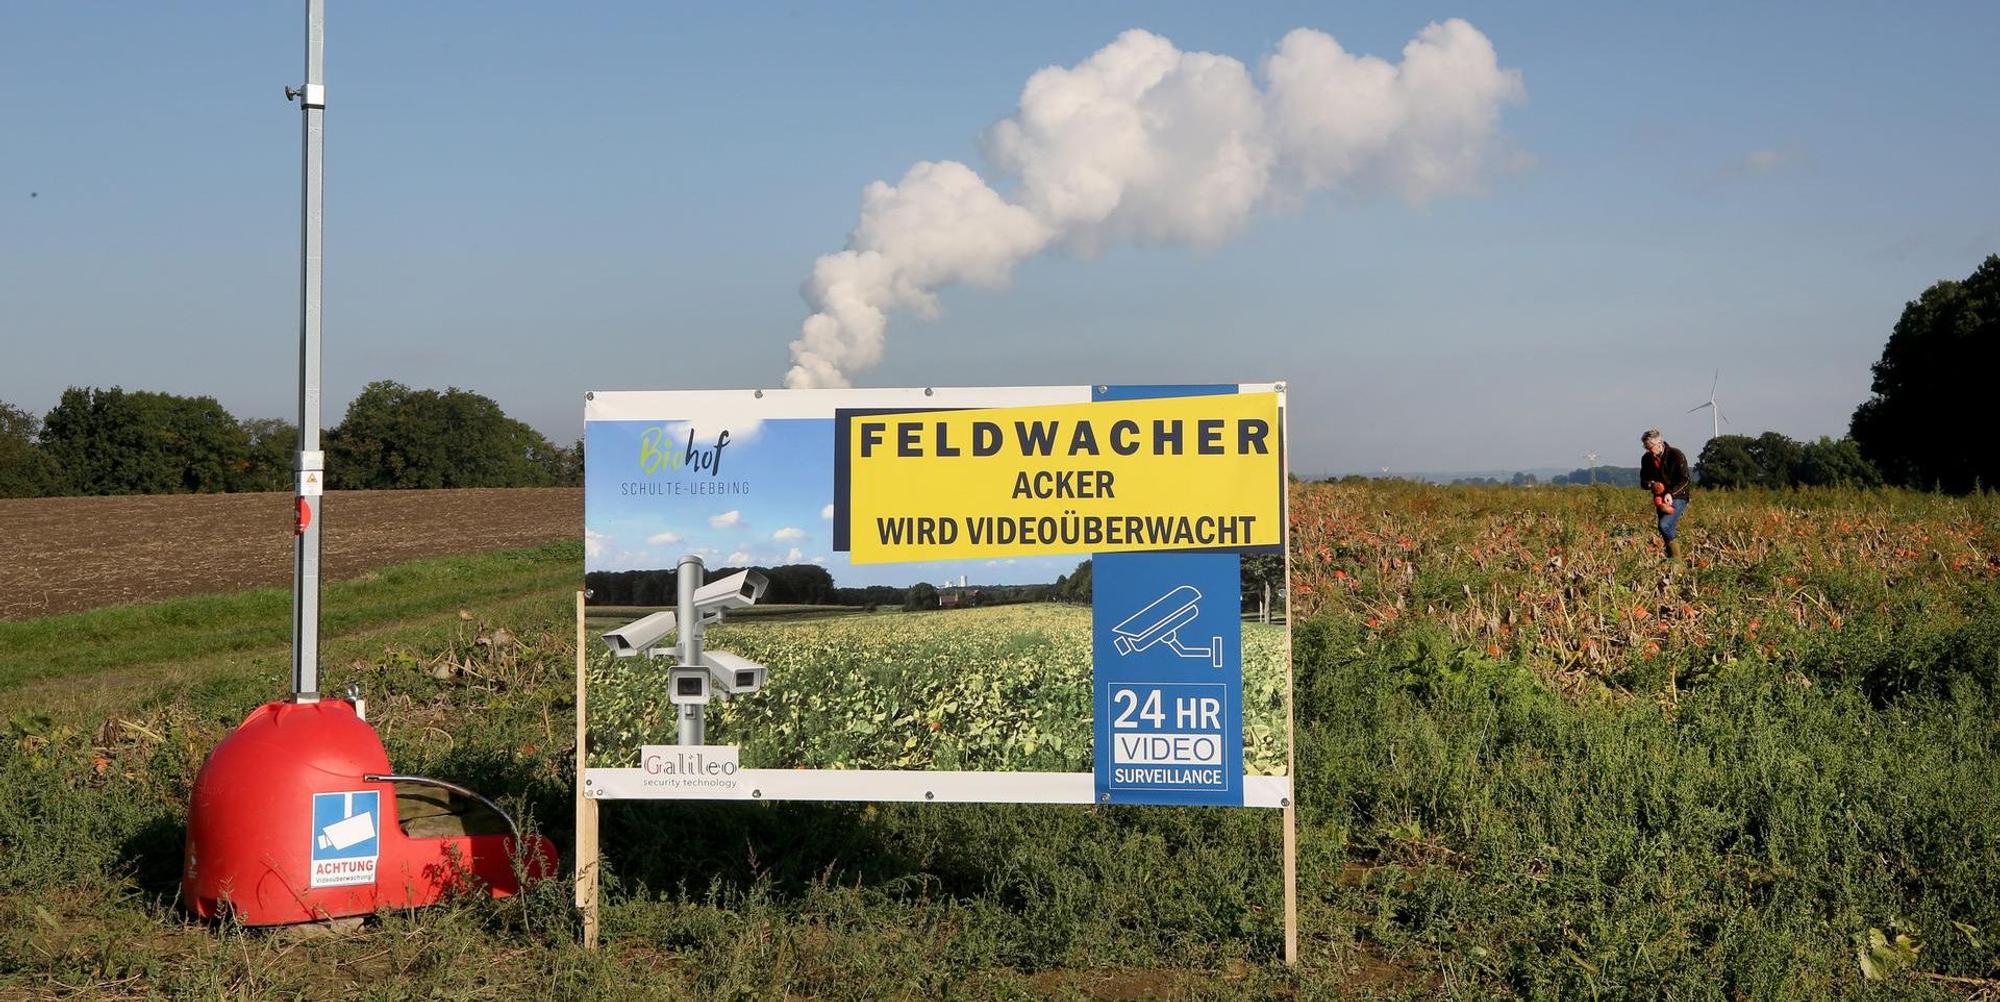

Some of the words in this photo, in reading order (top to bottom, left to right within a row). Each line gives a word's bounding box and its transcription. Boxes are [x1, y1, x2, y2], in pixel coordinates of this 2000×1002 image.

[860, 418, 1270, 458] FELDWACHER
[639, 426, 731, 477] Biohof
[621, 481, 751, 496] SCHULTE-UEBBING
[1011, 470, 1116, 499] ACKER
[876, 516, 959, 546] WIRD
[965, 509, 1257, 545] VIDEOÜBERWACHT
[1113, 688, 1166, 729] 24
[1176, 697, 1222, 730] HR
[1121, 736, 1216, 762] VIDEO
[643, 753, 738, 776] Galileo
[1114, 767, 1222, 786] SURVEILLANCE
[643, 778, 681, 789] security
[683, 778, 737, 789] technology
[316, 860, 374, 875] ACHTUNG
